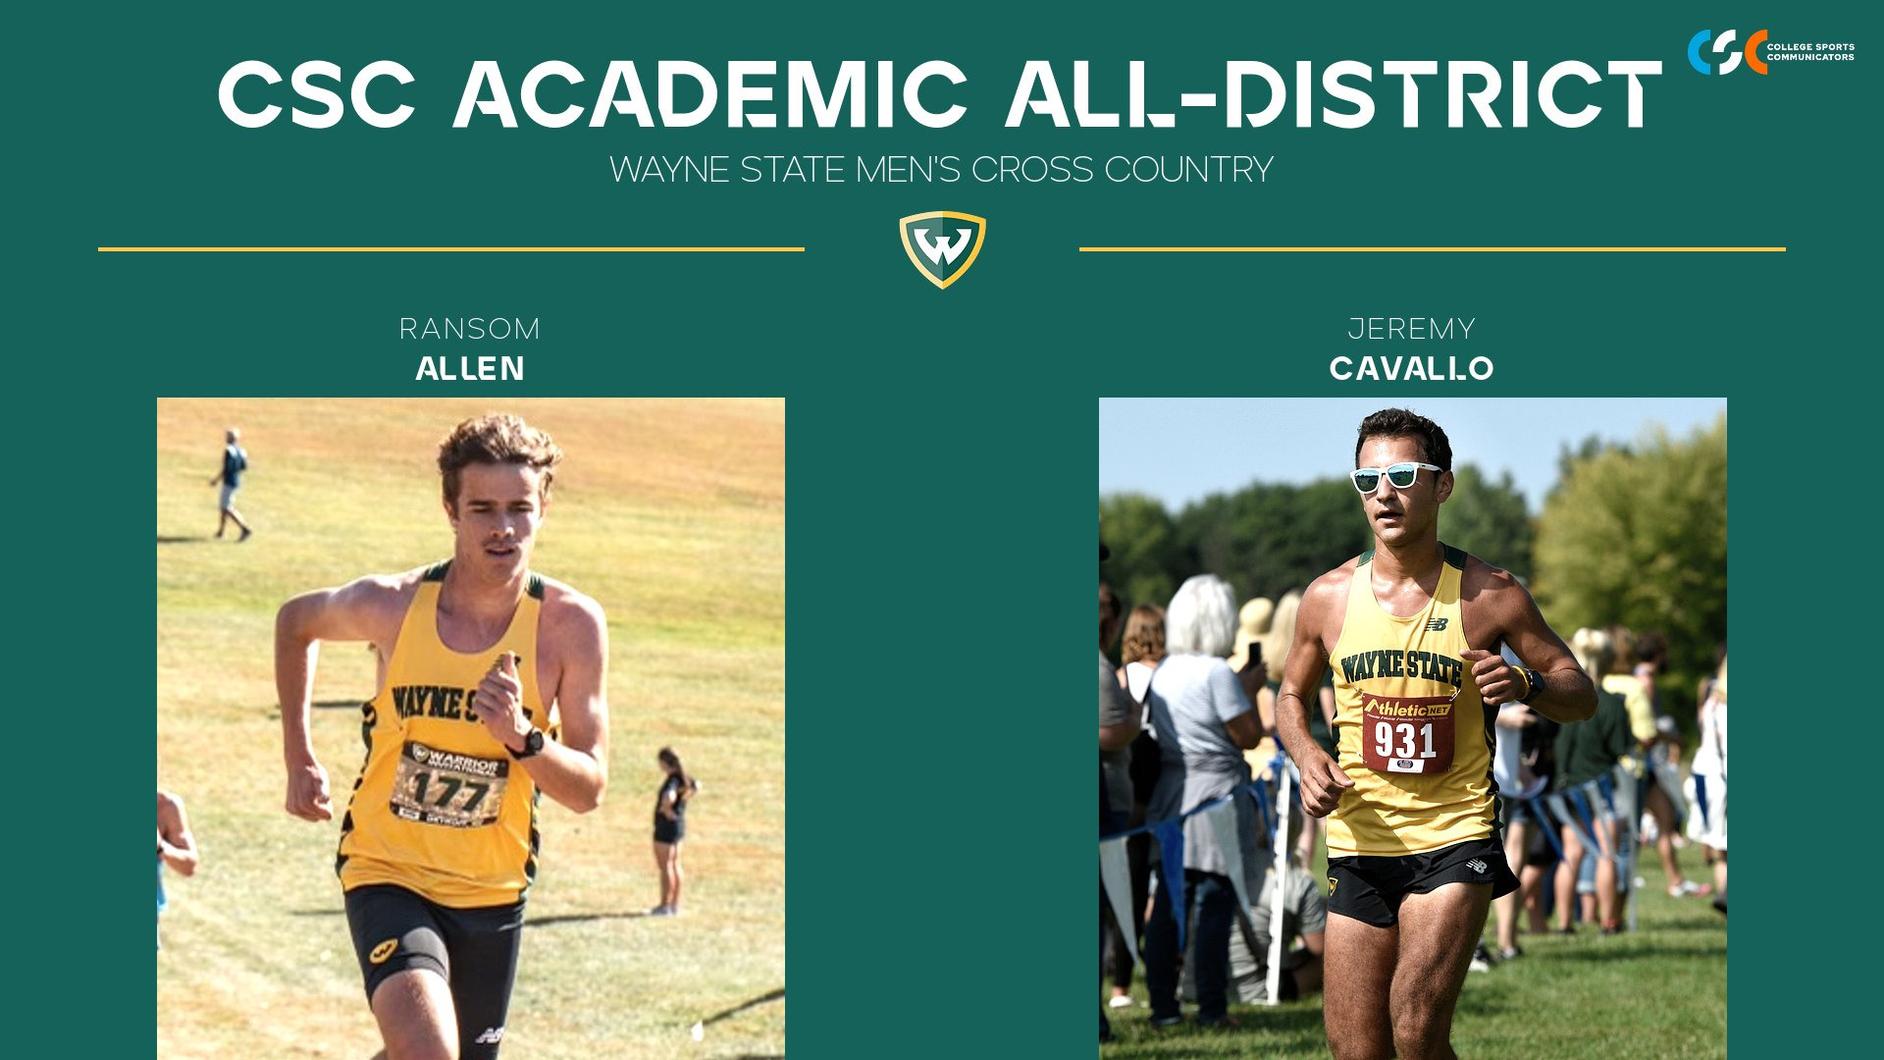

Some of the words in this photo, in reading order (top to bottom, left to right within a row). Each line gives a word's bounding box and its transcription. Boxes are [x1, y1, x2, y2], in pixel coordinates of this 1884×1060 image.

[1341, 649, 1405, 684] WAYNE
[1406, 650, 1464, 689] STATE
[391, 684, 465, 720] WAYNE
[1364, 698, 1428, 717] Athletic
[1428, 705, 1449, 715] NET
[1375, 721, 1437, 759] 931
[429, 750, 499, 772] WARRIOR
[414, 772, 490, 813] 177
